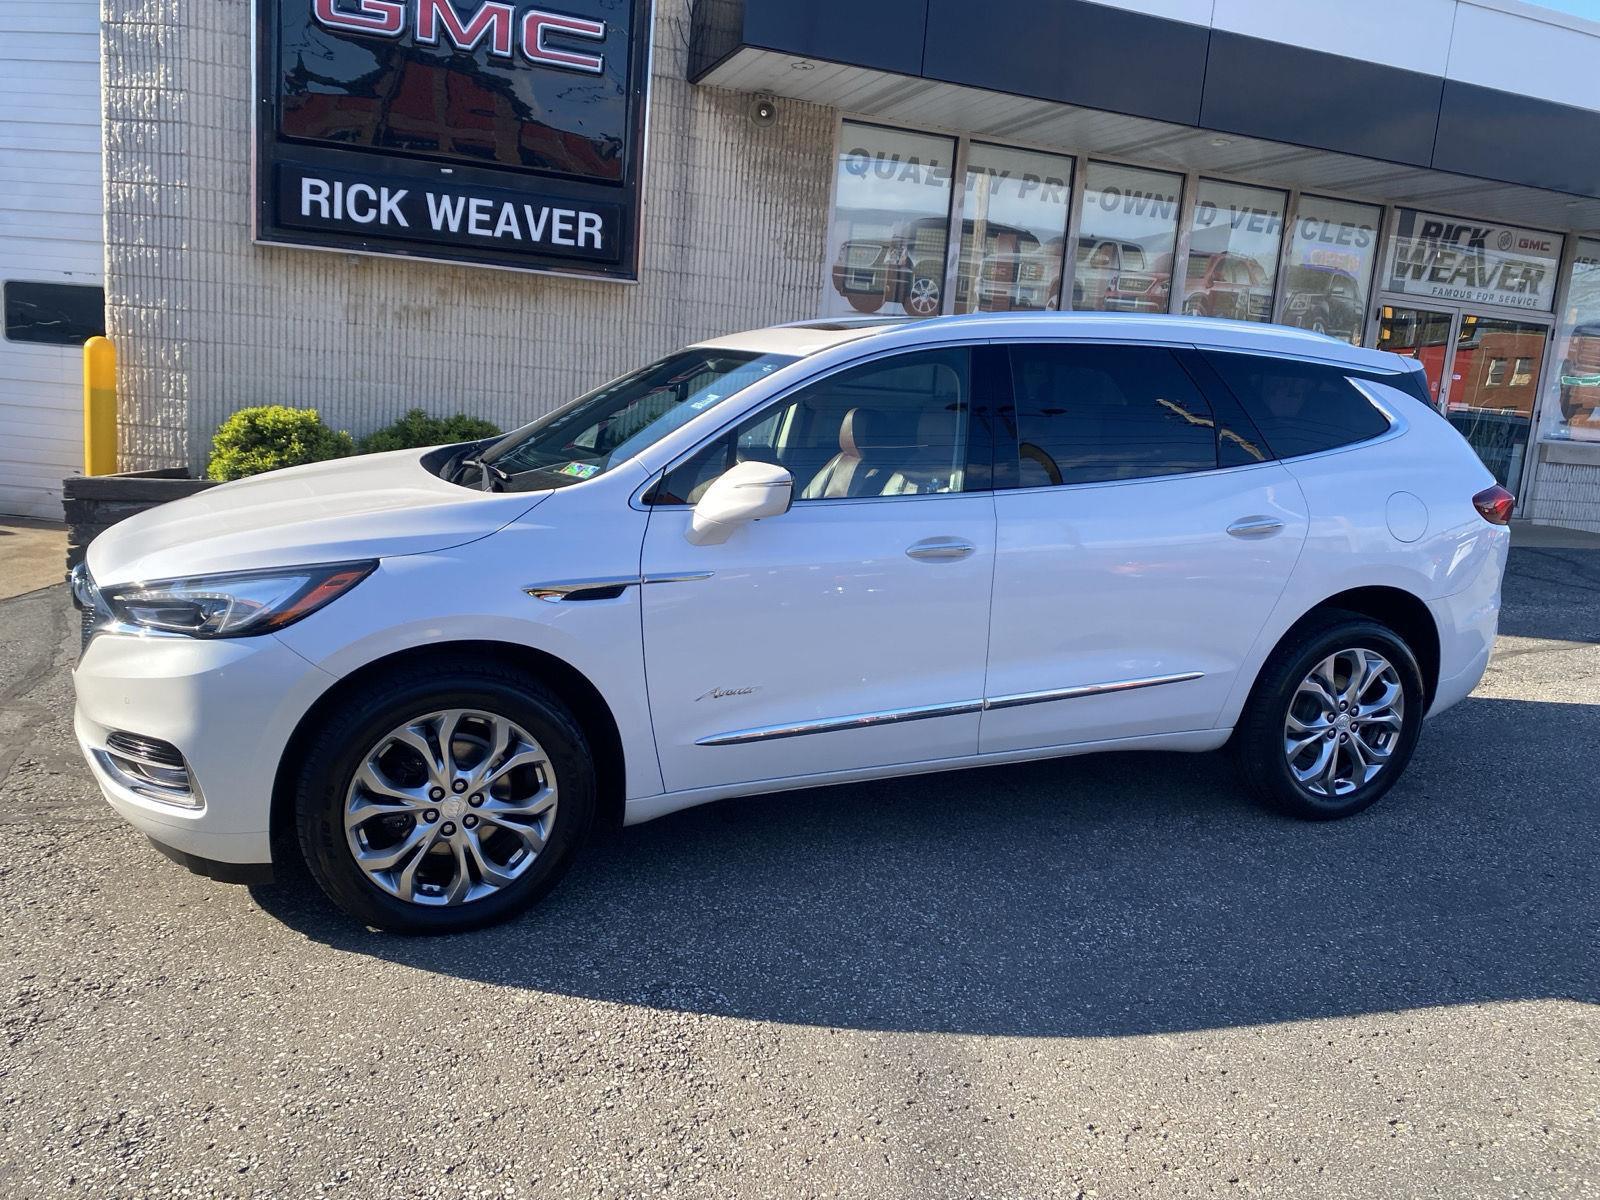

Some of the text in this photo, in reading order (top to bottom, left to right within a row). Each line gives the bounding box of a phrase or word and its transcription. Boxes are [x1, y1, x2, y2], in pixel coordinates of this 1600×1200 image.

[313, 0, 606, 74] GMC
[301, 177, 603, 249] RICK WEAVER
[846, 147, 1372, 248] QUALTY PR-OWND VEHCLES
[1419, 219, 1494, 253] RICK
[1518, 238, 1551, 252] GMC
[1395, 244, 1546, 295] WEAVER
[1431, 286, 1539, 307] FAMOUS FOR SERVICE
